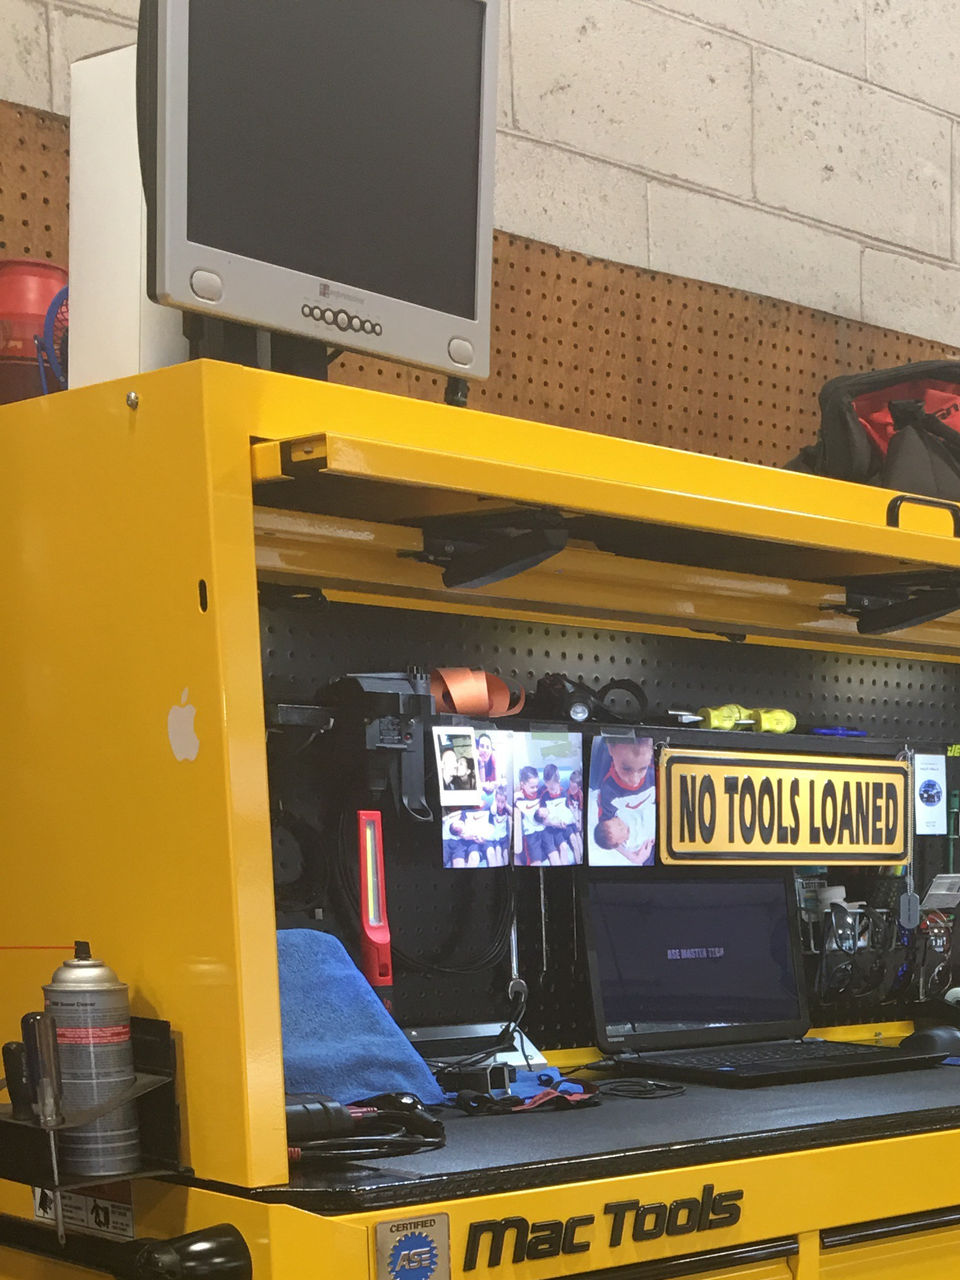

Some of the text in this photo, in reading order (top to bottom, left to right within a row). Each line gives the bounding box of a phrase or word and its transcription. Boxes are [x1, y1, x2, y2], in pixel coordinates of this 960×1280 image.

[679, 773, 899, 846] NO TOOLS LOANED
[667, 947, 724, 960] ASE MASTER TECH
[389, 1218, 436, 1233] CERTIFIED
[462, 1183, 744, 1272] Mac Tools
[395, 1247, 432, 1271] ASE
